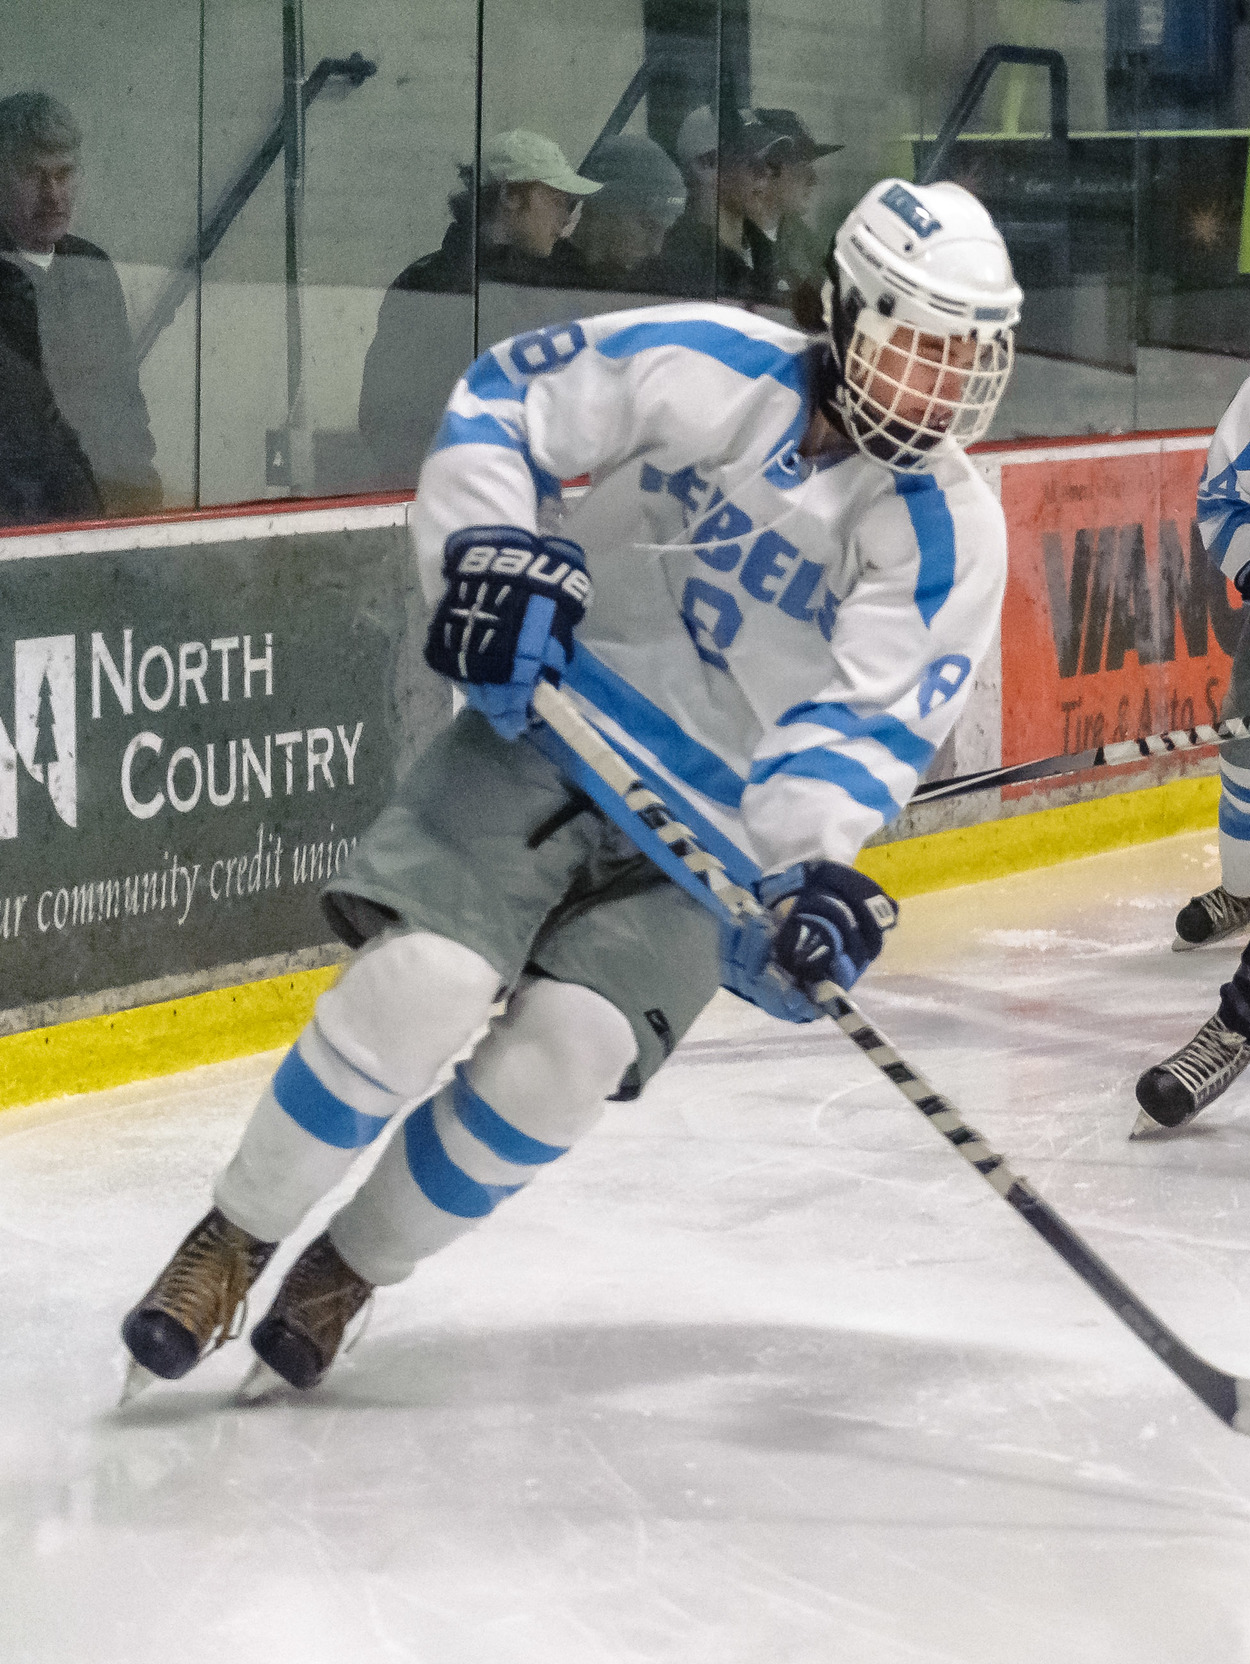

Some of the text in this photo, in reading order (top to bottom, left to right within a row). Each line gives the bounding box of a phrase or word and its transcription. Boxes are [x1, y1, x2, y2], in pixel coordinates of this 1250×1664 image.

[510, 321, 586, 375] 8
[92, 629, 274, 720] NORTH
[121, 721, 364, 820] COUNTRY
[37, 851, 201, 932] community
[209, 823, 283, 900] credit
[293, 823, 357, 885] unio
